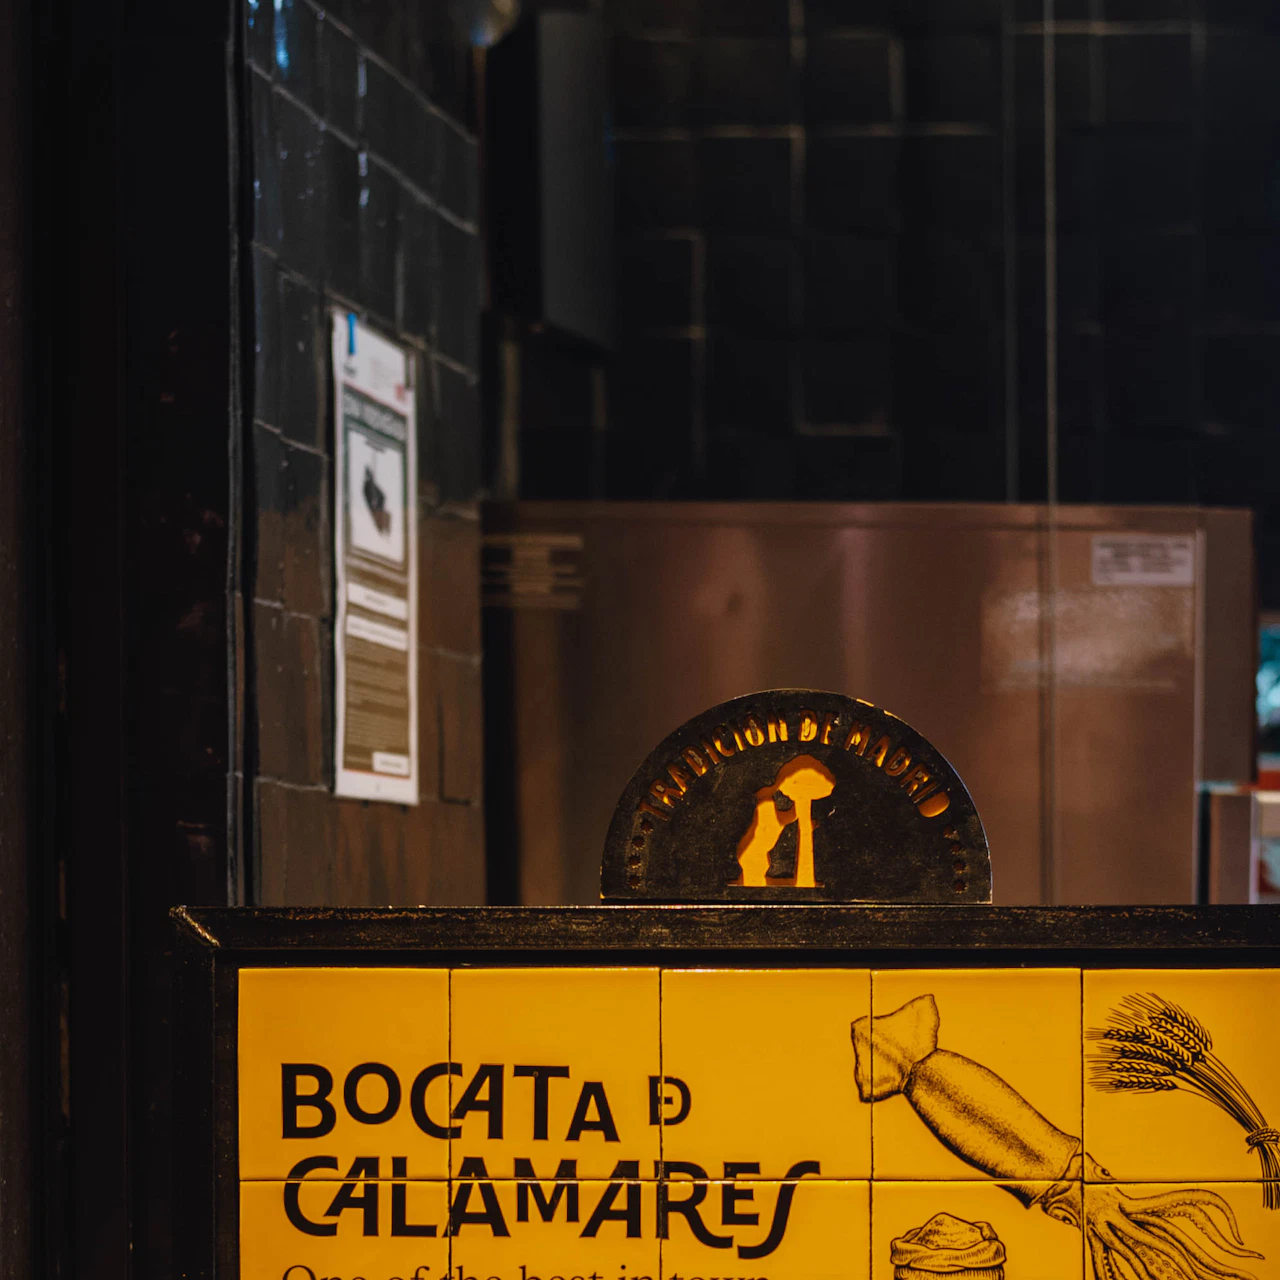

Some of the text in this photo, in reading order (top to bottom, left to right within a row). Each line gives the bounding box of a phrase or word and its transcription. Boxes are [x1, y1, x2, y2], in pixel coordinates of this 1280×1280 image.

[798, 708, 837, 744] DE
[843, 717, 951, 818] MADRID
[282, 1155, 821, 1260] CALAMARES
